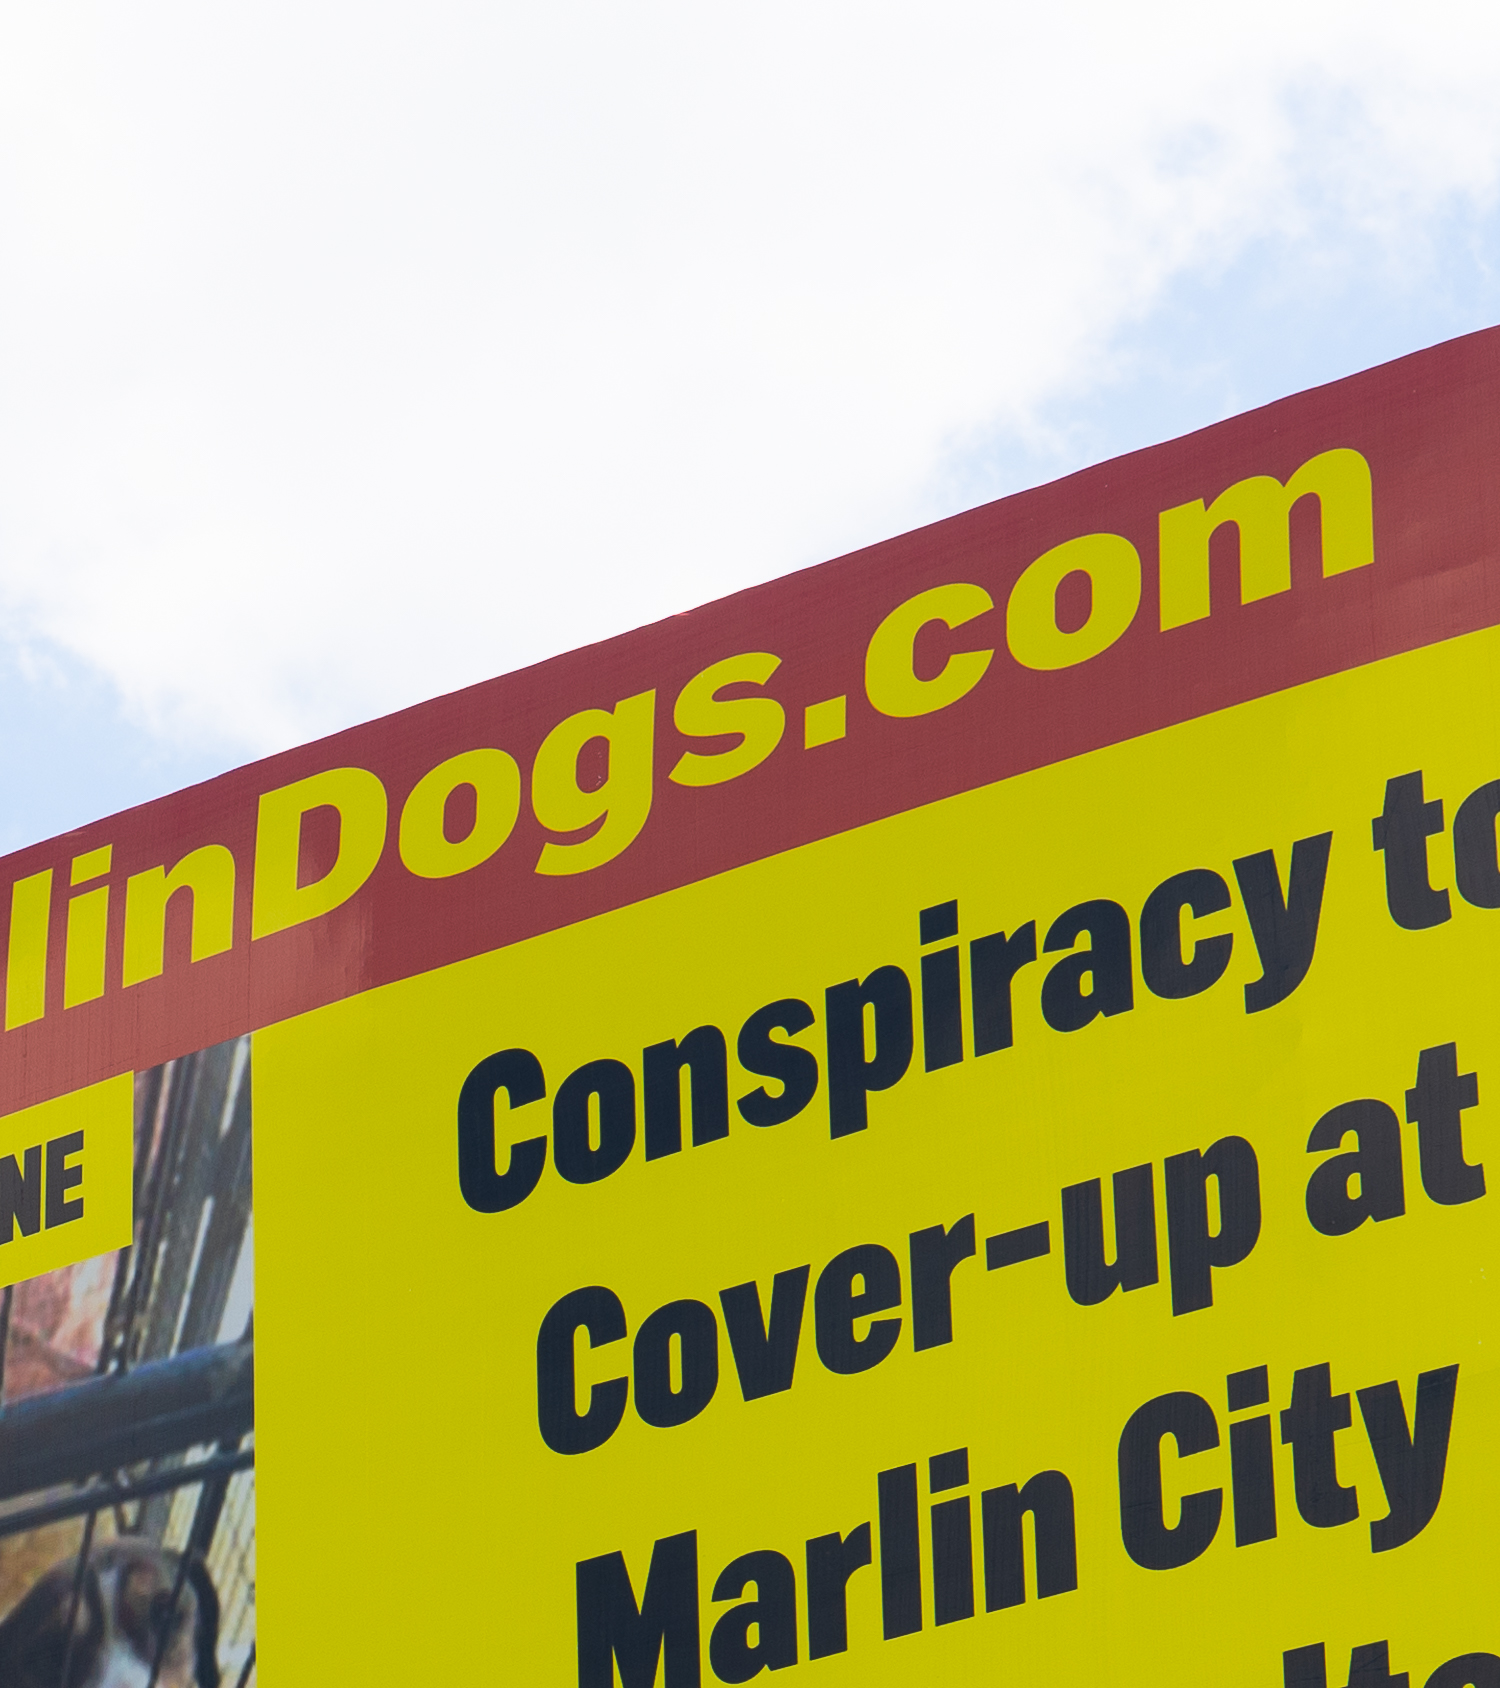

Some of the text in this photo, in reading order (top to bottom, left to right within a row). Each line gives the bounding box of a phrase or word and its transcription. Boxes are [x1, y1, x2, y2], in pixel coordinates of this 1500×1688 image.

[456, 829, 1335, 1215] Conspiracy
[535, 1040, 1488, 1457] Cover-up at
[1116, 1360, 1461, 1572] City
